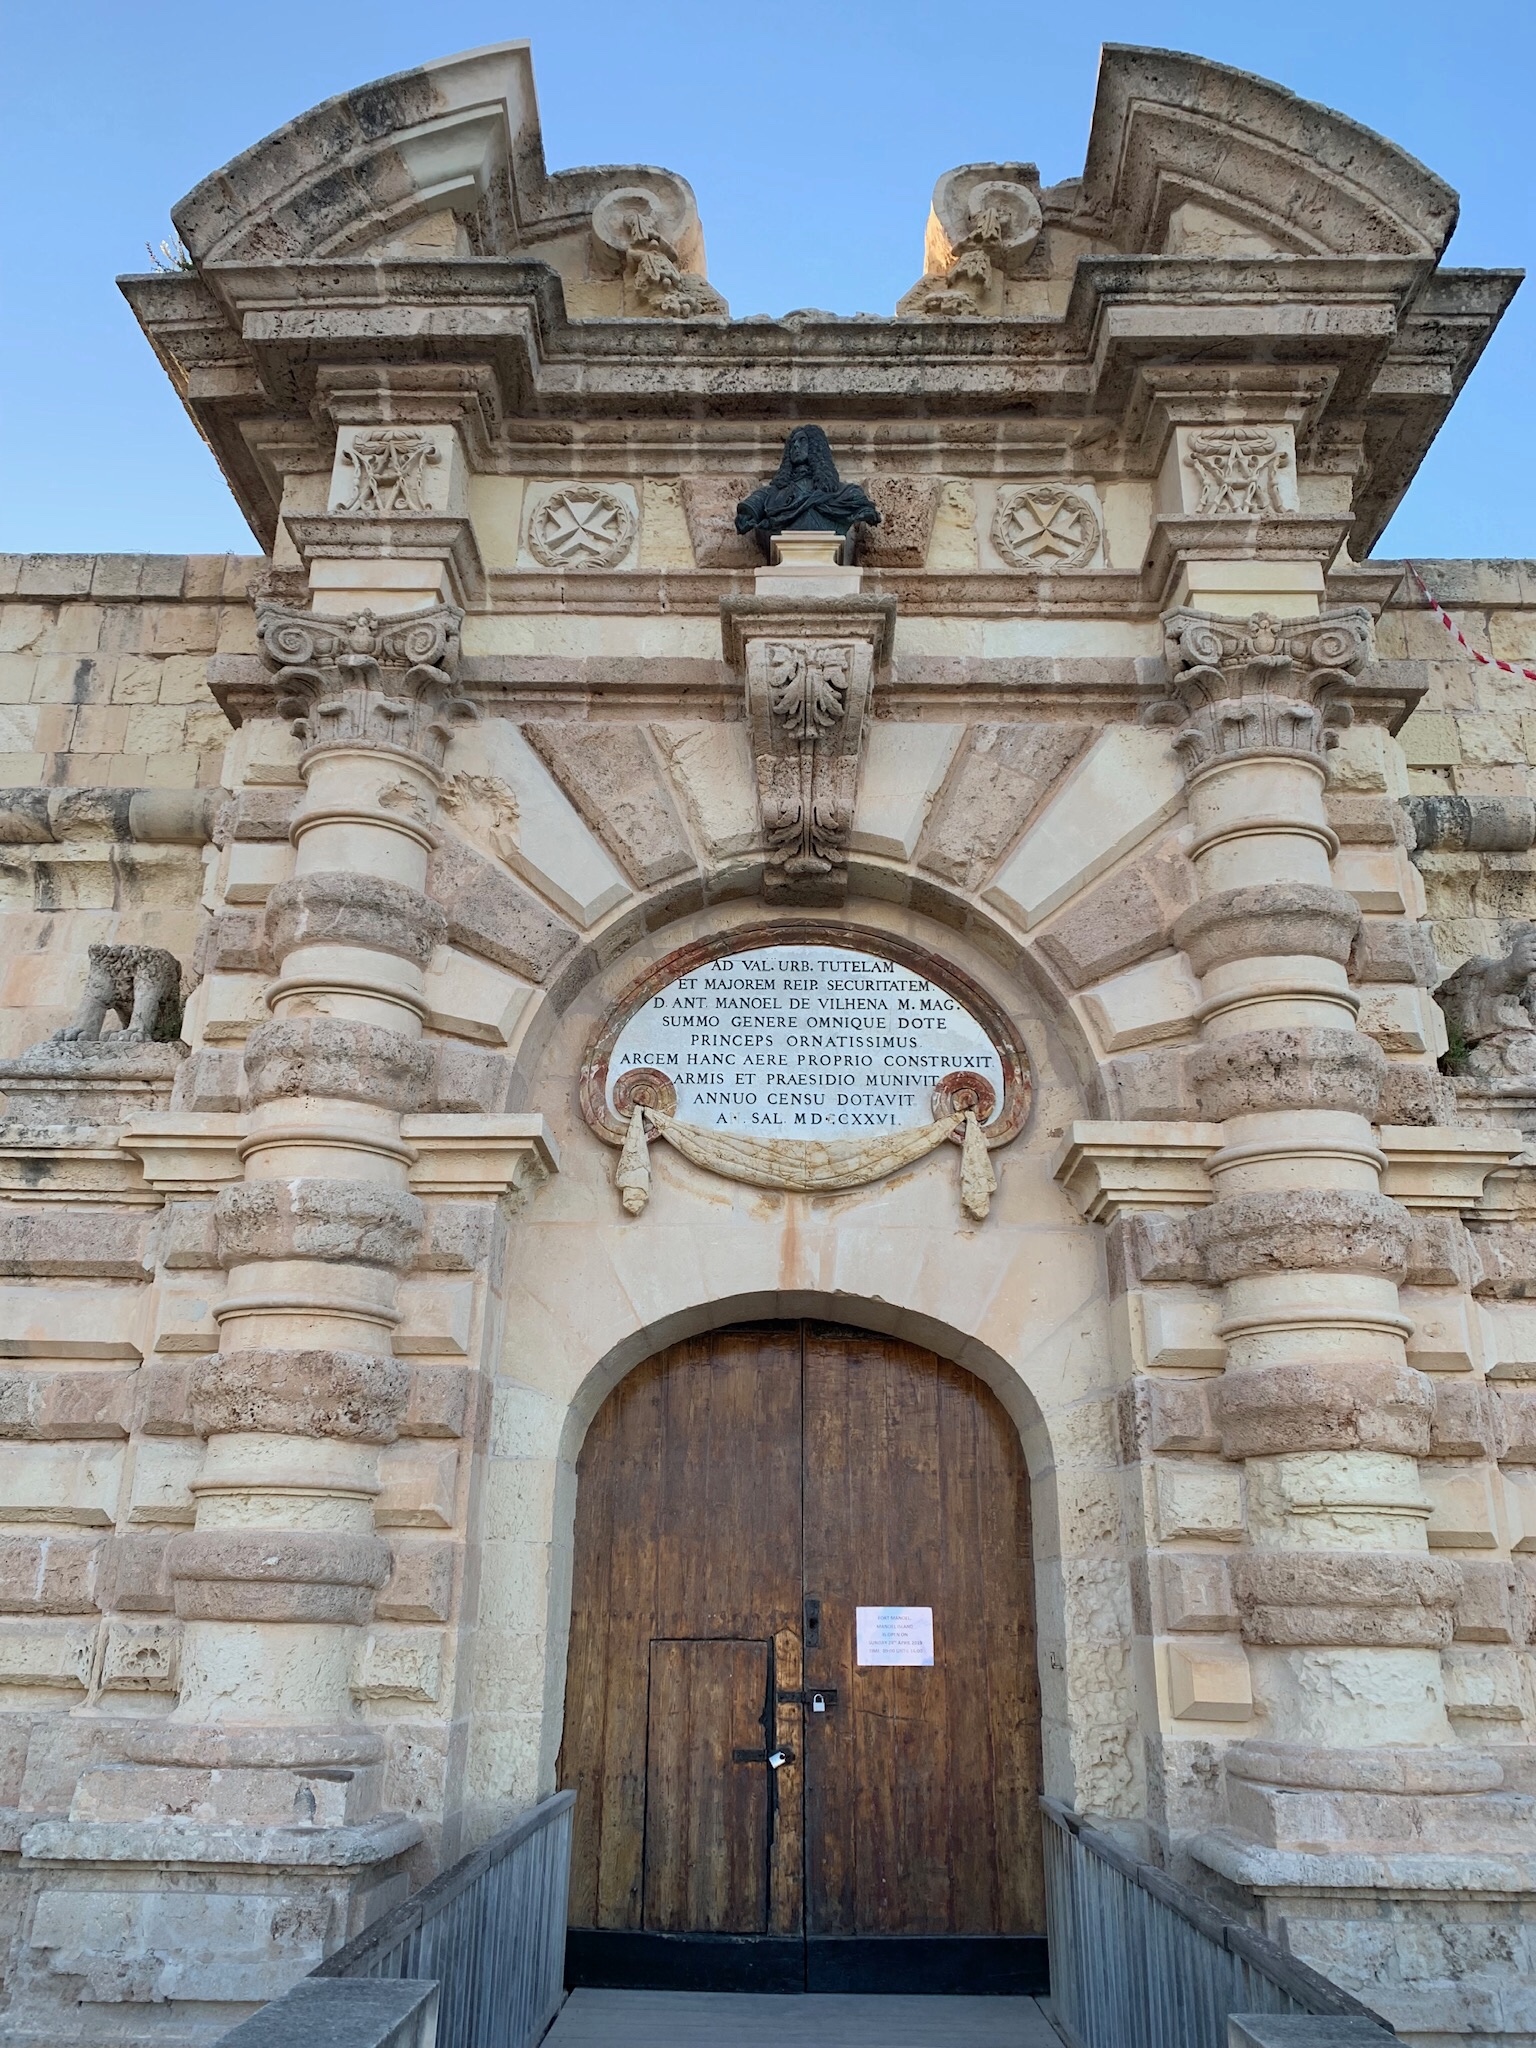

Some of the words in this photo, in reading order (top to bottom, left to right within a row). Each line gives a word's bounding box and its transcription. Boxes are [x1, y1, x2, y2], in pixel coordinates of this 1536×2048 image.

[710, 959, 734, 972] AD
[742, 960, 775, 972] VAL.
[778, 960, 814, 973] URB.
[818, 960, 895, 974] TUTELAM
[678, 978, 698, 990] ET
[704, 978, 776, 991] MAJOREM
[783, 979, 819, 991] REIP.
[827, 980, 936, 993] SECURITATEM.
[653, 997, 668, 1009] D.
[672, 997, 708, 1009] ANT.
[715, 998, 783, 1010] MANOEL
[789, 998, 811, 1010] DE
[817, 999, 889, 1011] VILHENA
[897, 999, 916, 1011] M.
[920, 999, 961, 1012] MAG.
[662, 1015, 720, 1028] SUMMO
[731, 1016, 798, 1028] GENERE
[806, 1016, 887, 1031] OMNIQUE
[898, 1018, 948, 1030] DOTE
[690, 1034, 774, 1047] PRINCEPS
[620, 1053, 679, 1066] ARCEM
[686, 1053, 736, 1066] HANC
[743, 1054, 788, 1066] AERE
[797, 1055, 873, 1067] PROPRIO
[673, 1073, 725, 1085] ARMIS
[735, 1073, 757, 1085] ET
[766, 1073, 856, 1086] PRAESIDIO
[866, 1074, 940, 1087] MUNIVIT
[692, 1092, 758, 1105] ANNUO
[767, 1093, 826, 1106] CENSU
